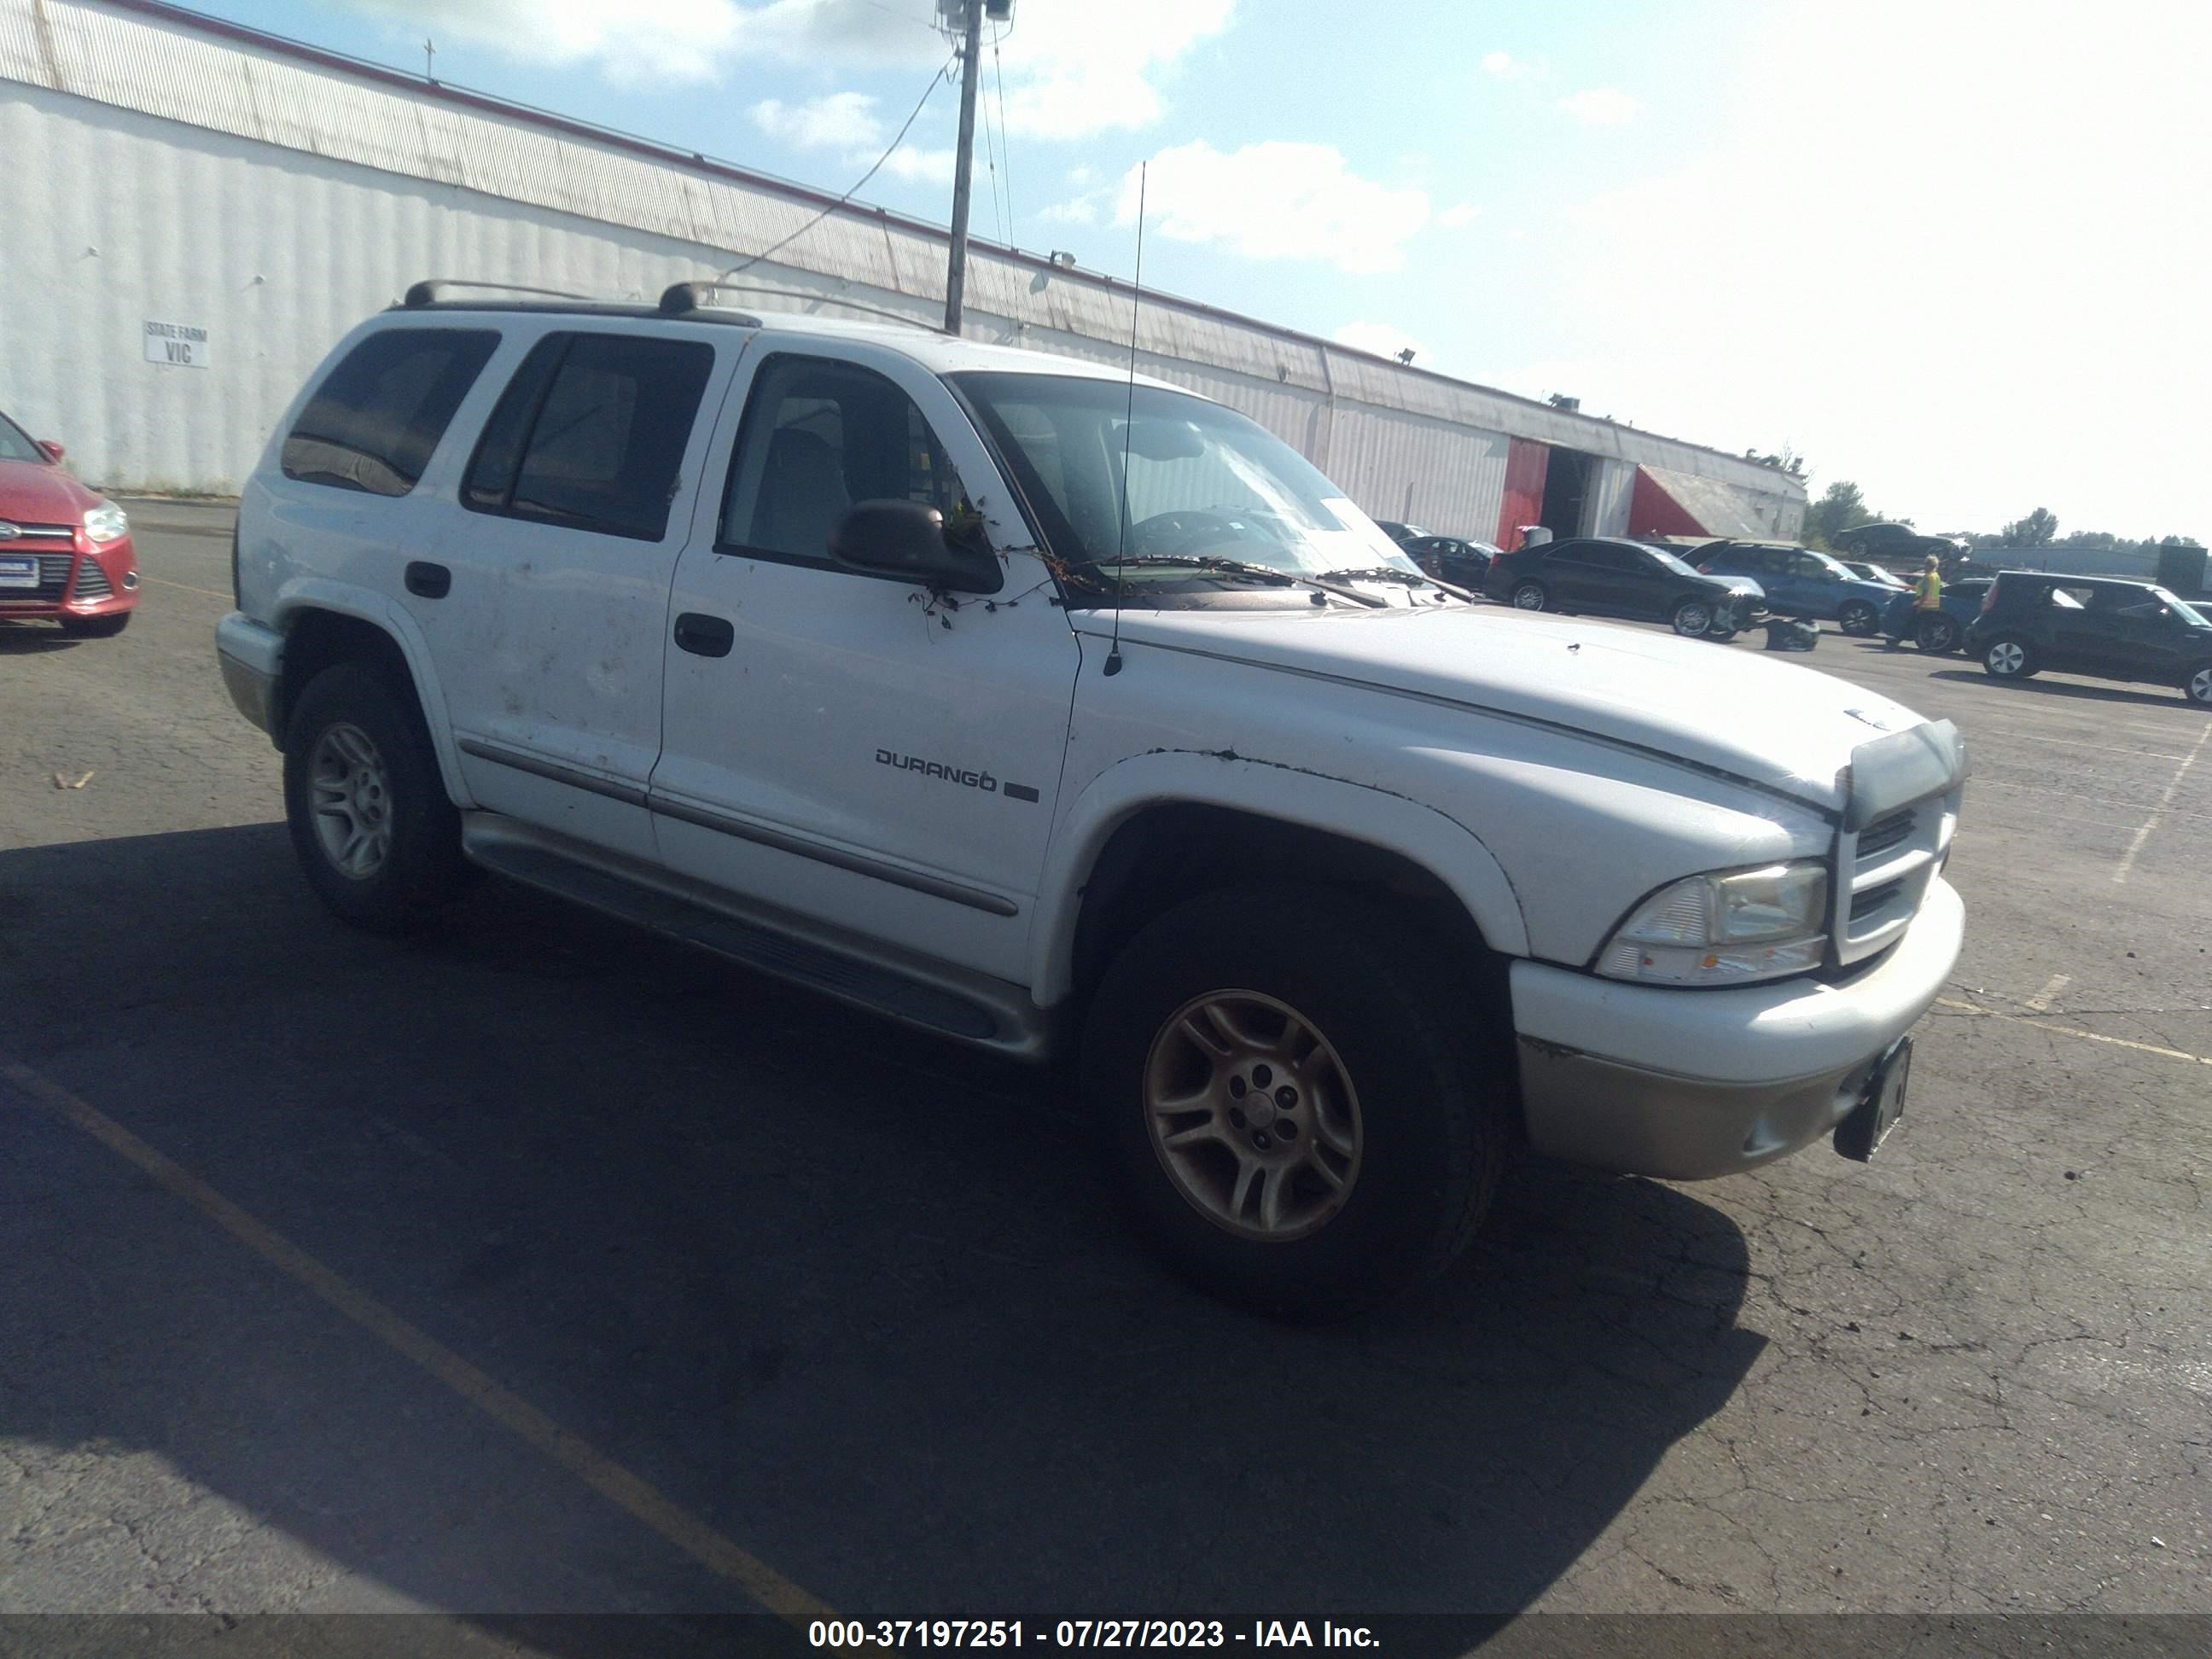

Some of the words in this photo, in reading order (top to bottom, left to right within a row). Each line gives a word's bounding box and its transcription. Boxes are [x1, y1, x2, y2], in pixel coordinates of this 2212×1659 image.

[147, 321, 176, 339] STATE
[178, 325, 207, 342] FARM
[165, 341, 192, 364] VIC
[876, 748, 998, 792] DURANGO
